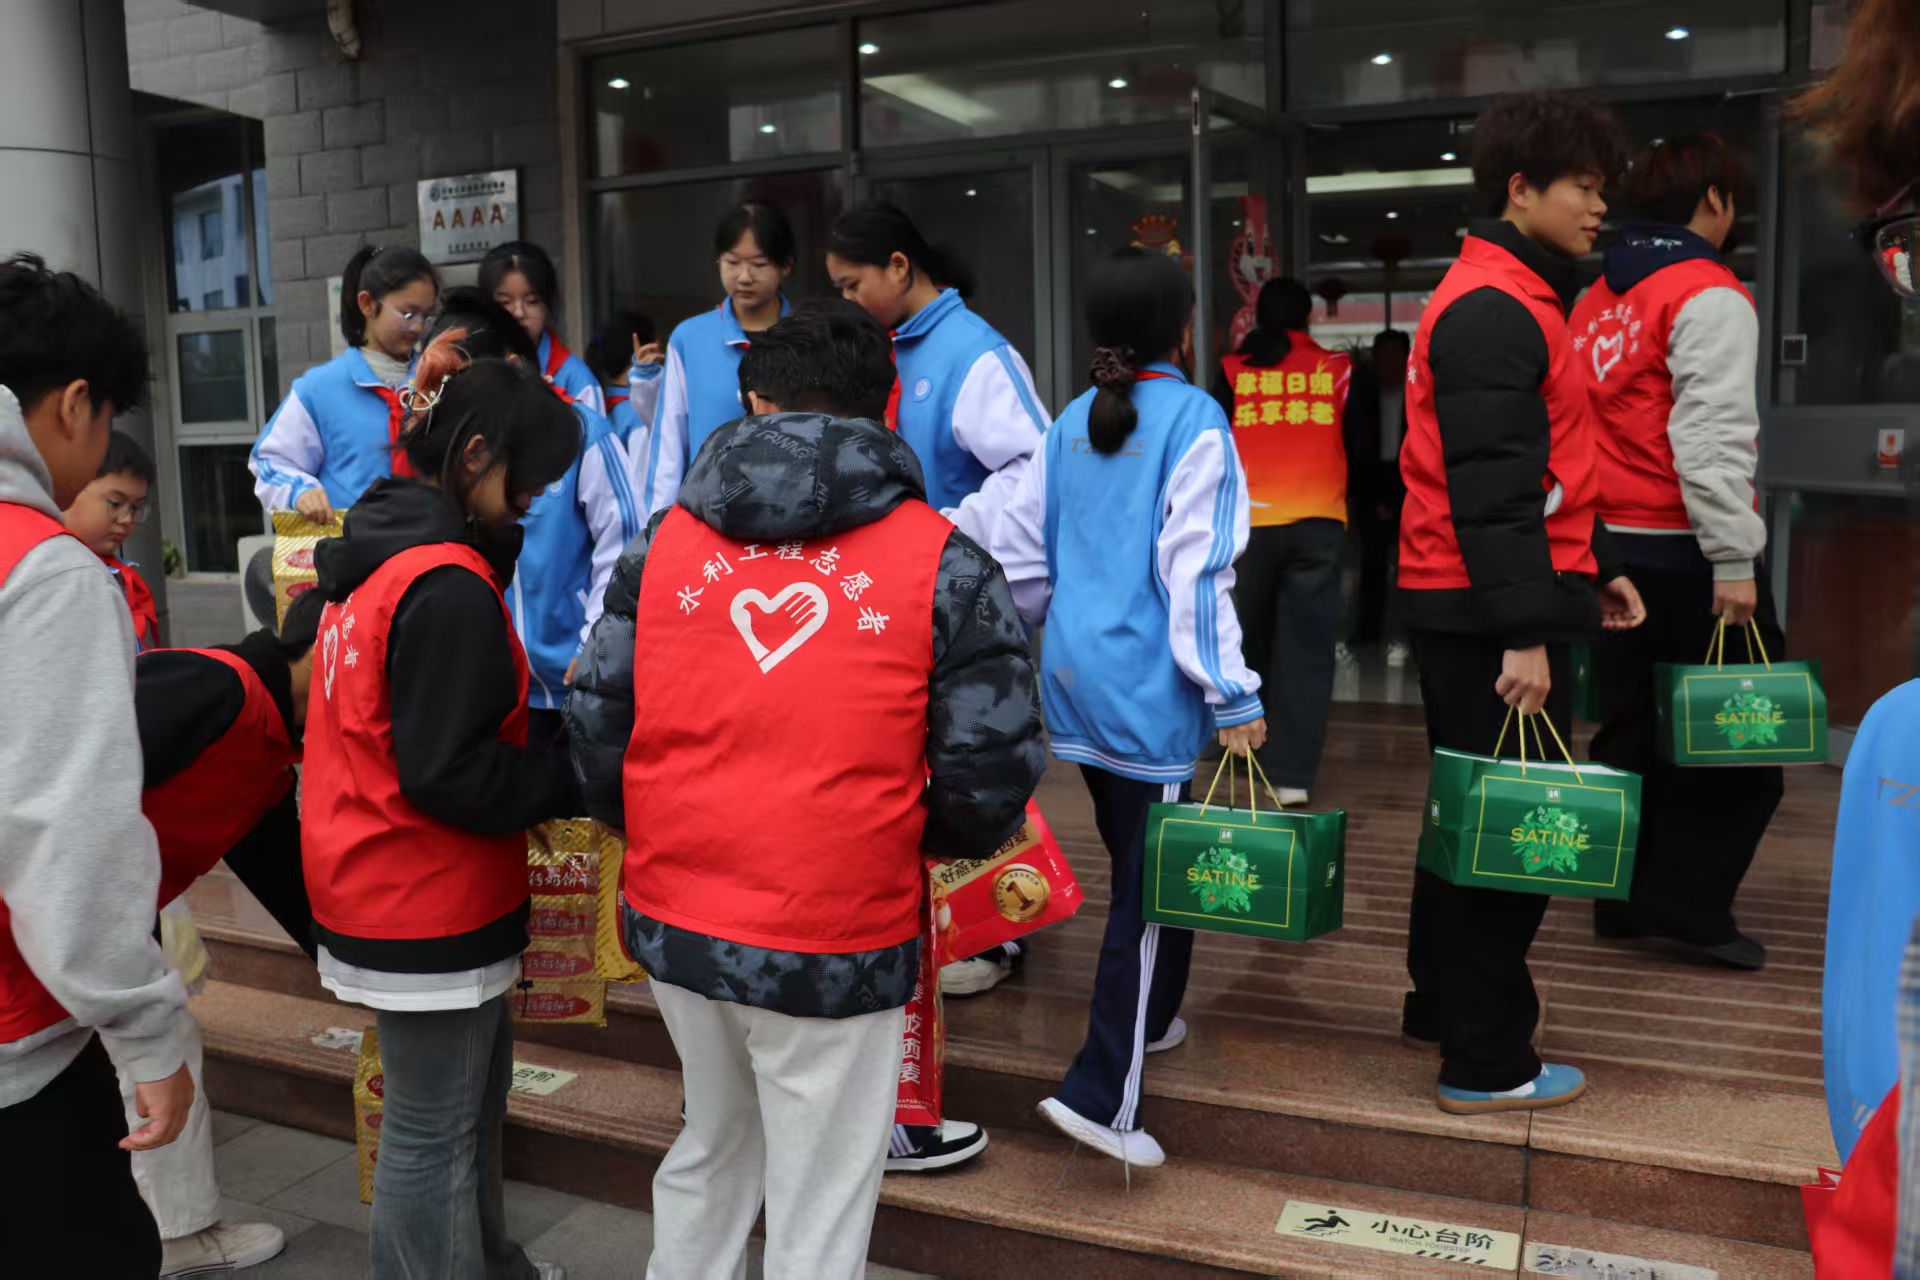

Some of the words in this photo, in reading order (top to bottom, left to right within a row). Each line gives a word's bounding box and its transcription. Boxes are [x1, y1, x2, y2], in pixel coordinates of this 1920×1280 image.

[677, 540, 890, 636] 水利工程志愿者
[1714, 711, 1785, 725] SATINE
[1511, 827, 1590, 849] SATINE
[1187, 867, 1260, 890] SATINE
[1006, 881, 1035, 911] 1
[1370, 1219, 1495, 1250] 小心台阶
